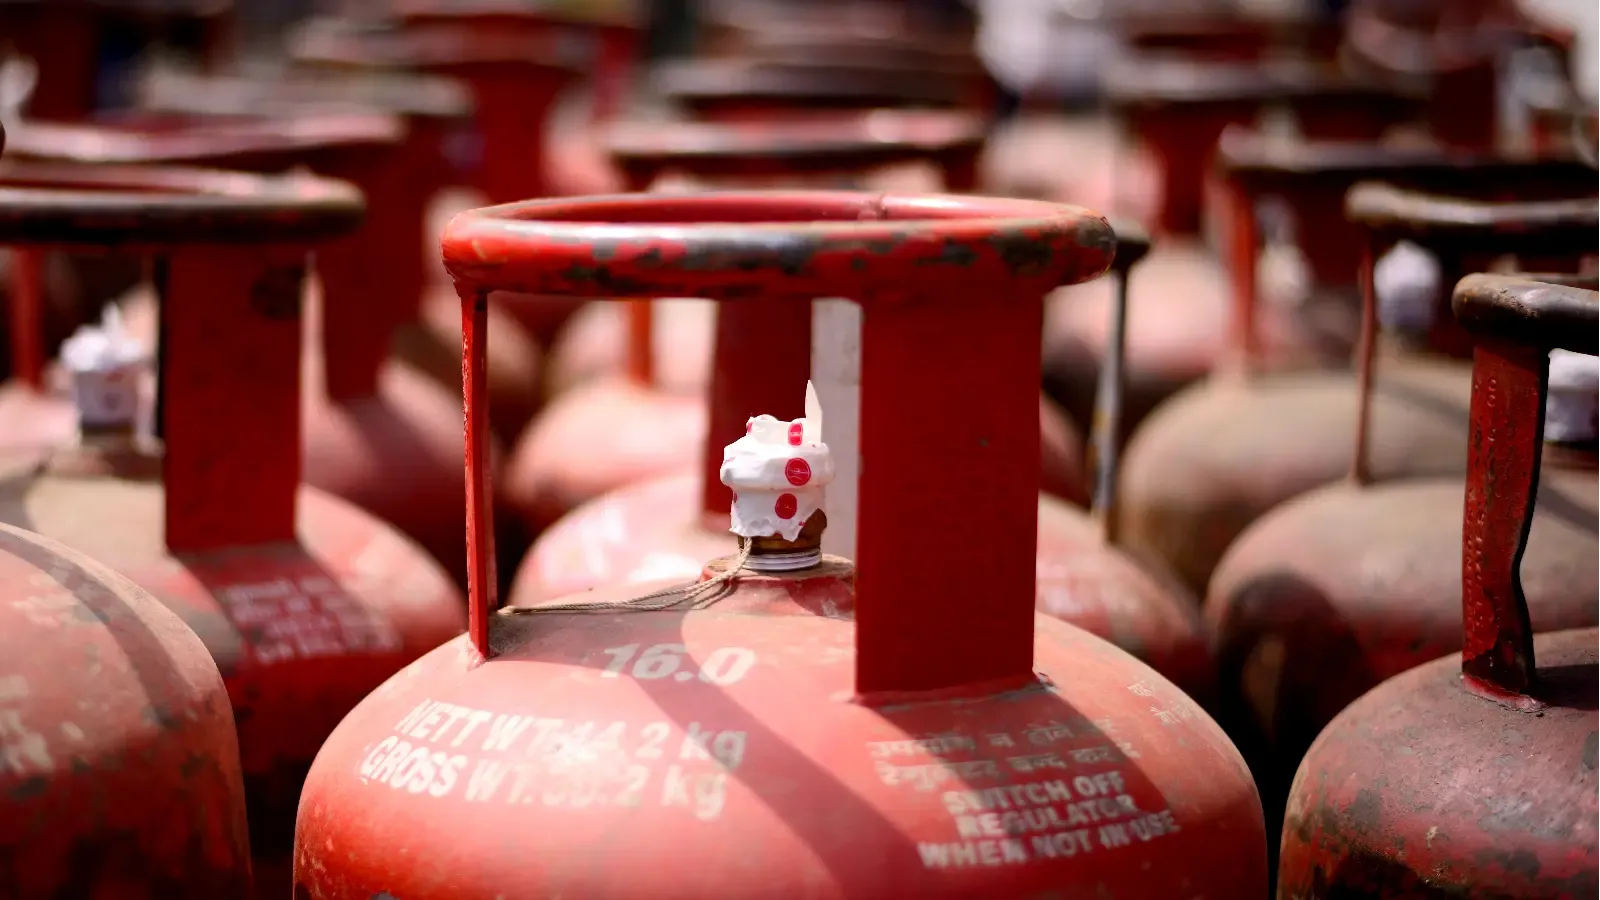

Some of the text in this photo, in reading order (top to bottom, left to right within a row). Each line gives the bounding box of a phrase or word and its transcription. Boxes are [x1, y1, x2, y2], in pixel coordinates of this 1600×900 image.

[600, 642, 756, 685] 16.0
[394, 698, 492, 748] NETT
[680, 721, 748, 770] kg
[359, 734, 469, 798] GROSS
[661, 764, 727, 822] kg
[943, 770, 1125, 815] SWITCH OFF
[917, 809, 1181, 869] WHEN NOT IN USE
[954, 794, 1138, 839] REGULATOR
